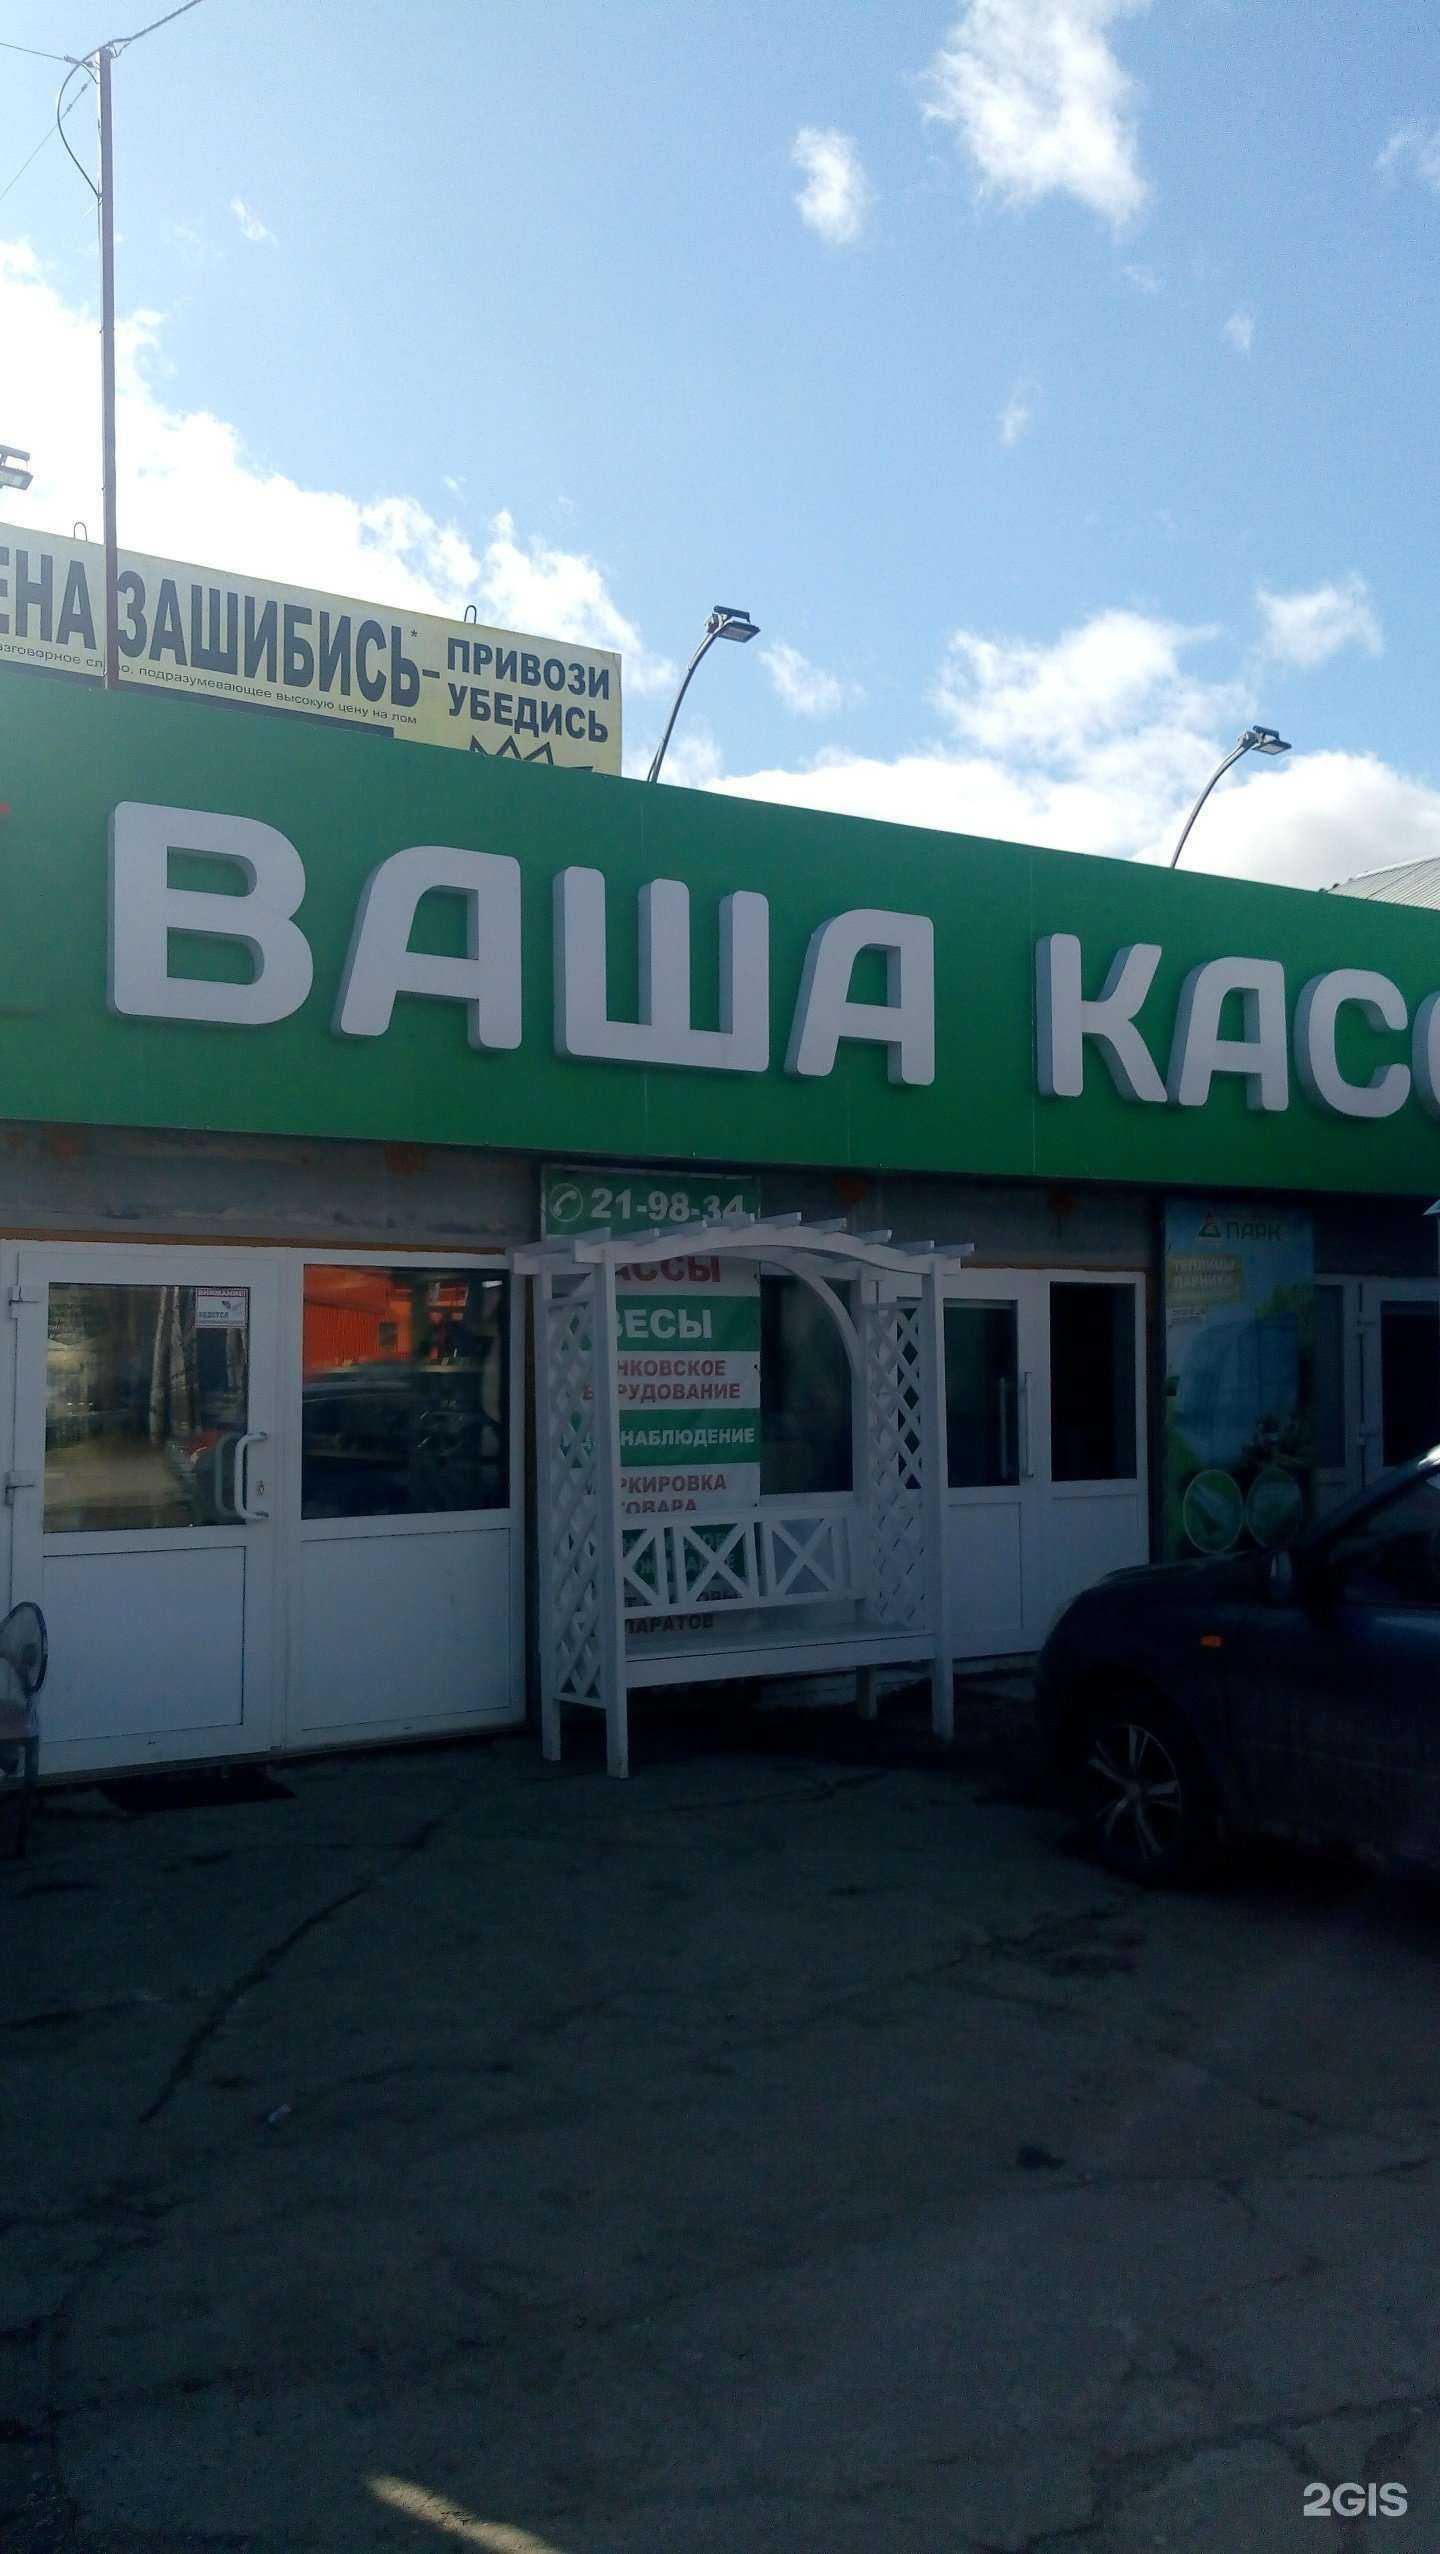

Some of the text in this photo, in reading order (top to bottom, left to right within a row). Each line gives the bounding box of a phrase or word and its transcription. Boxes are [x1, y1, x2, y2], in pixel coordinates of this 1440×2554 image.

[0, 642, 81, 666] зговорное
[139, 667, 273, 699] подразумевающее
[276, 692, 334, 711] высокую
[338, 703, 369, 718] цену
[373, 709, 389, 721] на
[392, 711, 417, 725] лом
[447, 637, 610, 700] ПРИВОЗИ
[448, 682, 609, 743] УБЕДИСЬ
[107, 800, 1440, 1120] ВАША КАС
[589, 1187, 745, 1222] 21-98-34
